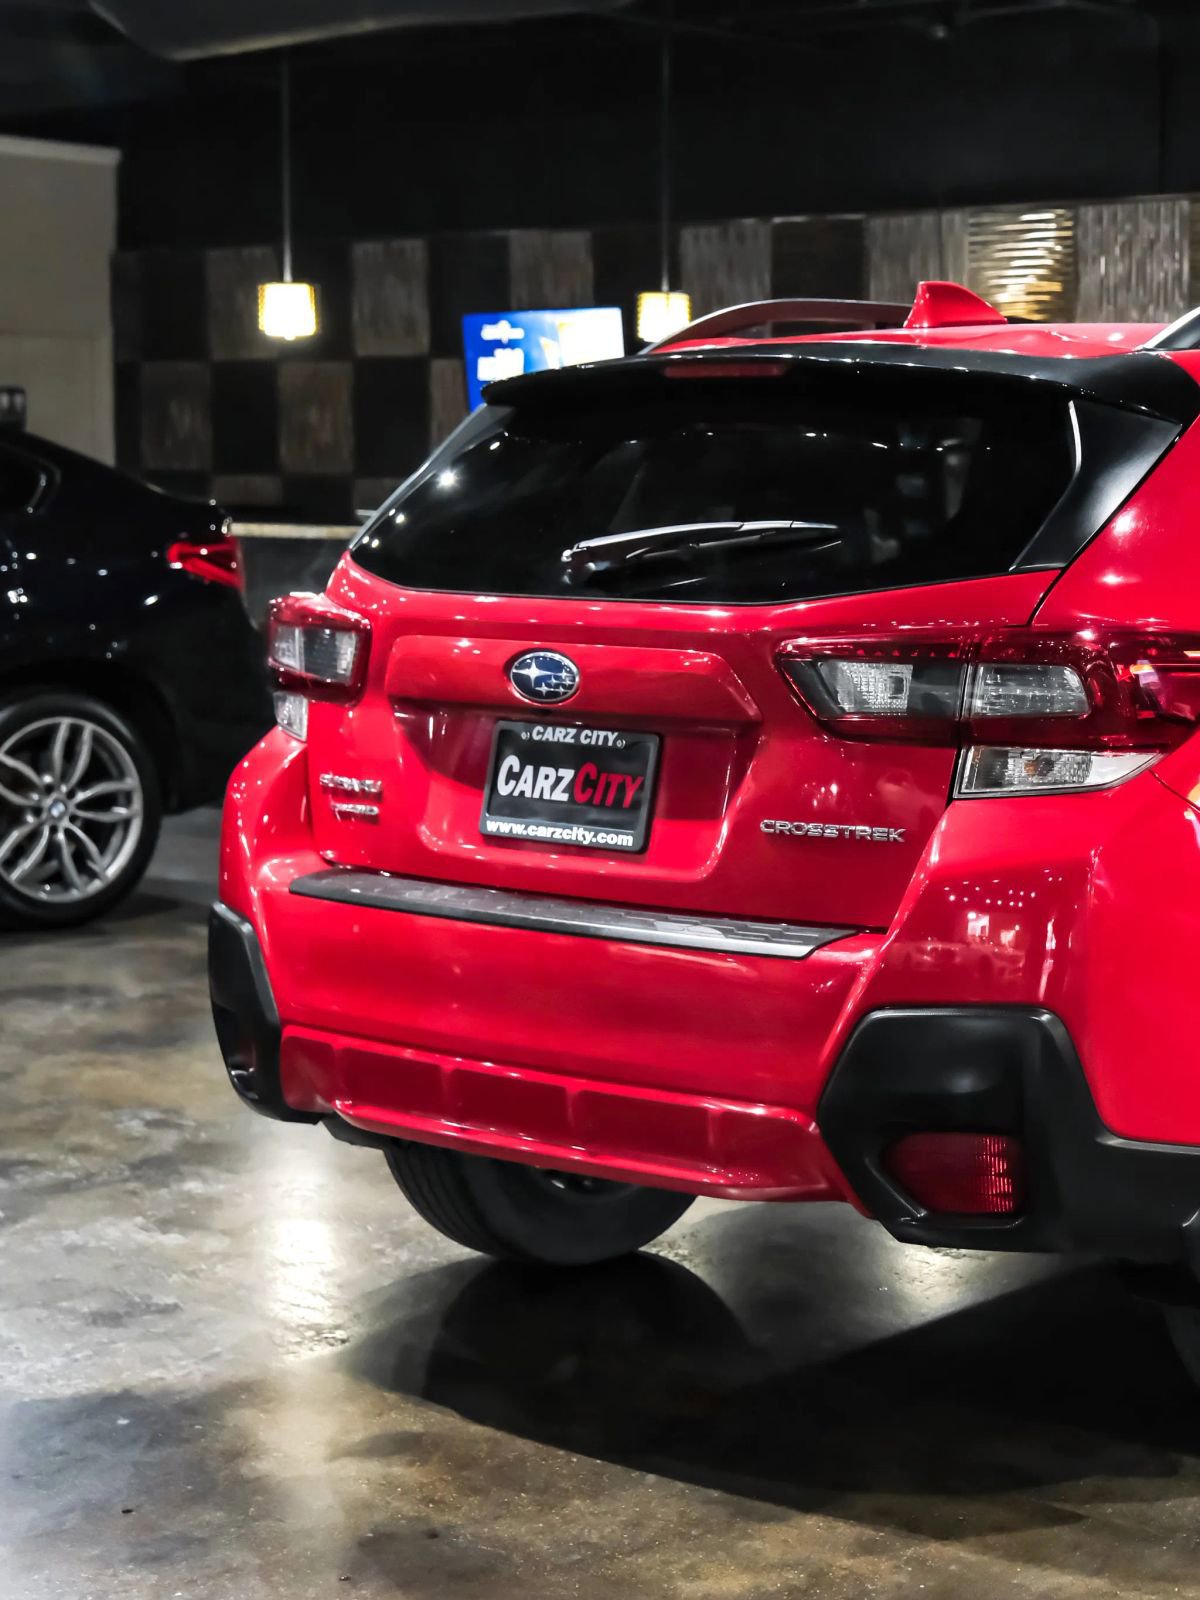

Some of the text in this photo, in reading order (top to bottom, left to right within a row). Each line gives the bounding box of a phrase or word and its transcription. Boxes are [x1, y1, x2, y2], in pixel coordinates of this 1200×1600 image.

[532, 725, 618, 747] CARZ CITY
[486, 820, 634, 847] www.carzcity.com
[760, 819, 907, 843] CROSSTREK
